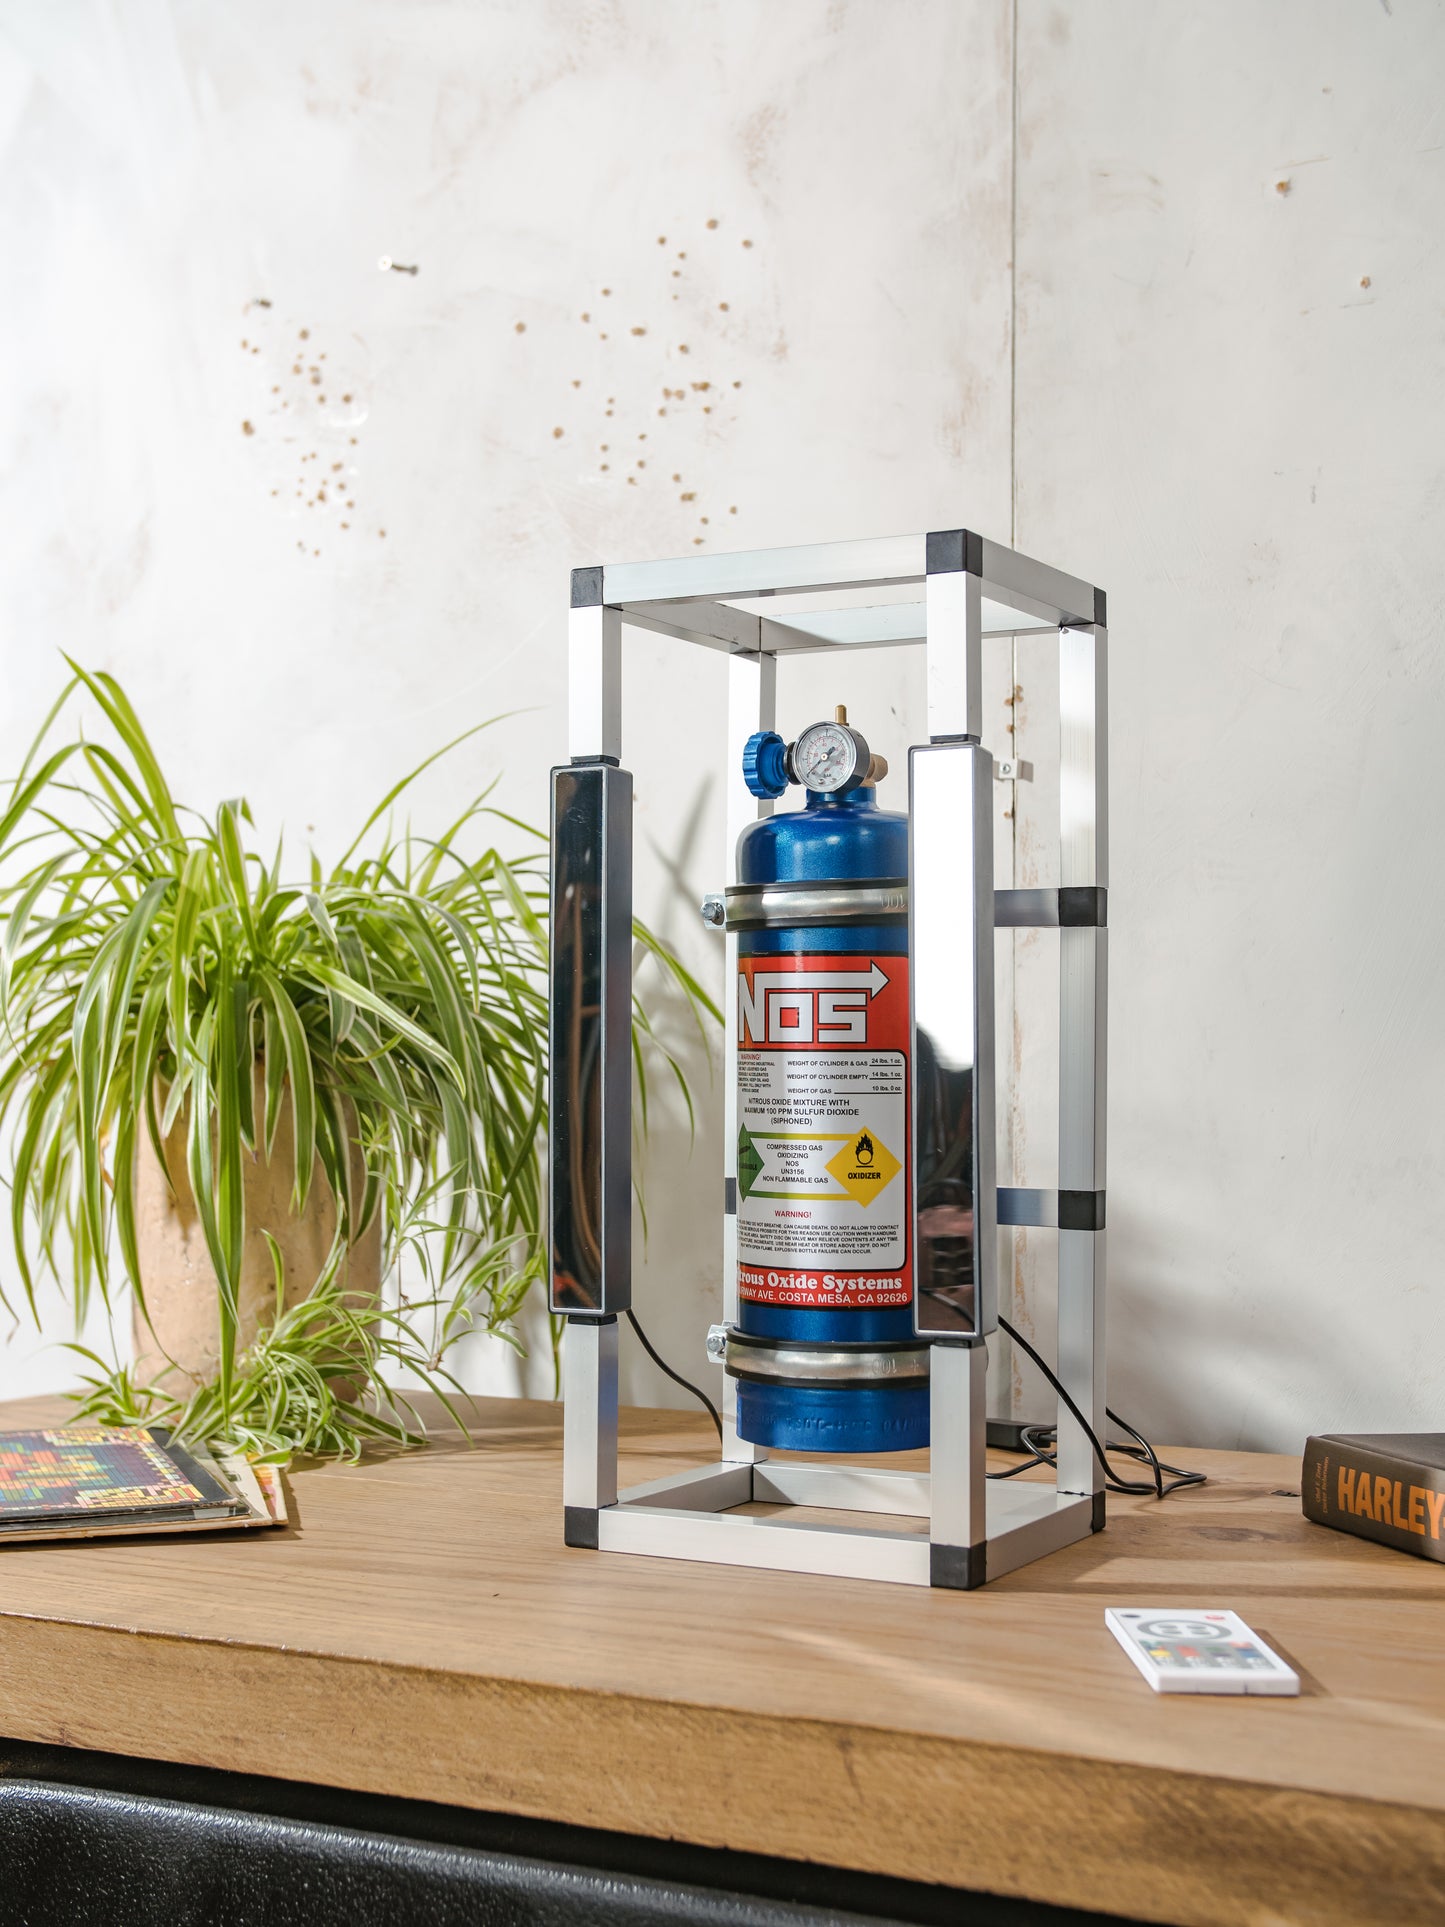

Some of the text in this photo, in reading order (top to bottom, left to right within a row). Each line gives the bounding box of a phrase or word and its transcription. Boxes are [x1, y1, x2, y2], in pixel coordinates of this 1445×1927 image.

[738, 971, 868, 1044] NOS
[771, 1117, 813, 1126] (SIPHONED)
[775, 1210, 812, 1218] WARNING!
[738, 1270, 902, 1293] trous Oxide Systems
[741, 1286, 756, 1298] RWAY
[758, 1290, 776, 1300] AVE.
[778, 1292, 814, 1302] COSTA
[857, 1294, 874, 1303] CA
[876, 1292, 908, 1303] 92626
[1338, 1466, 1445, 1540] HARLEY
